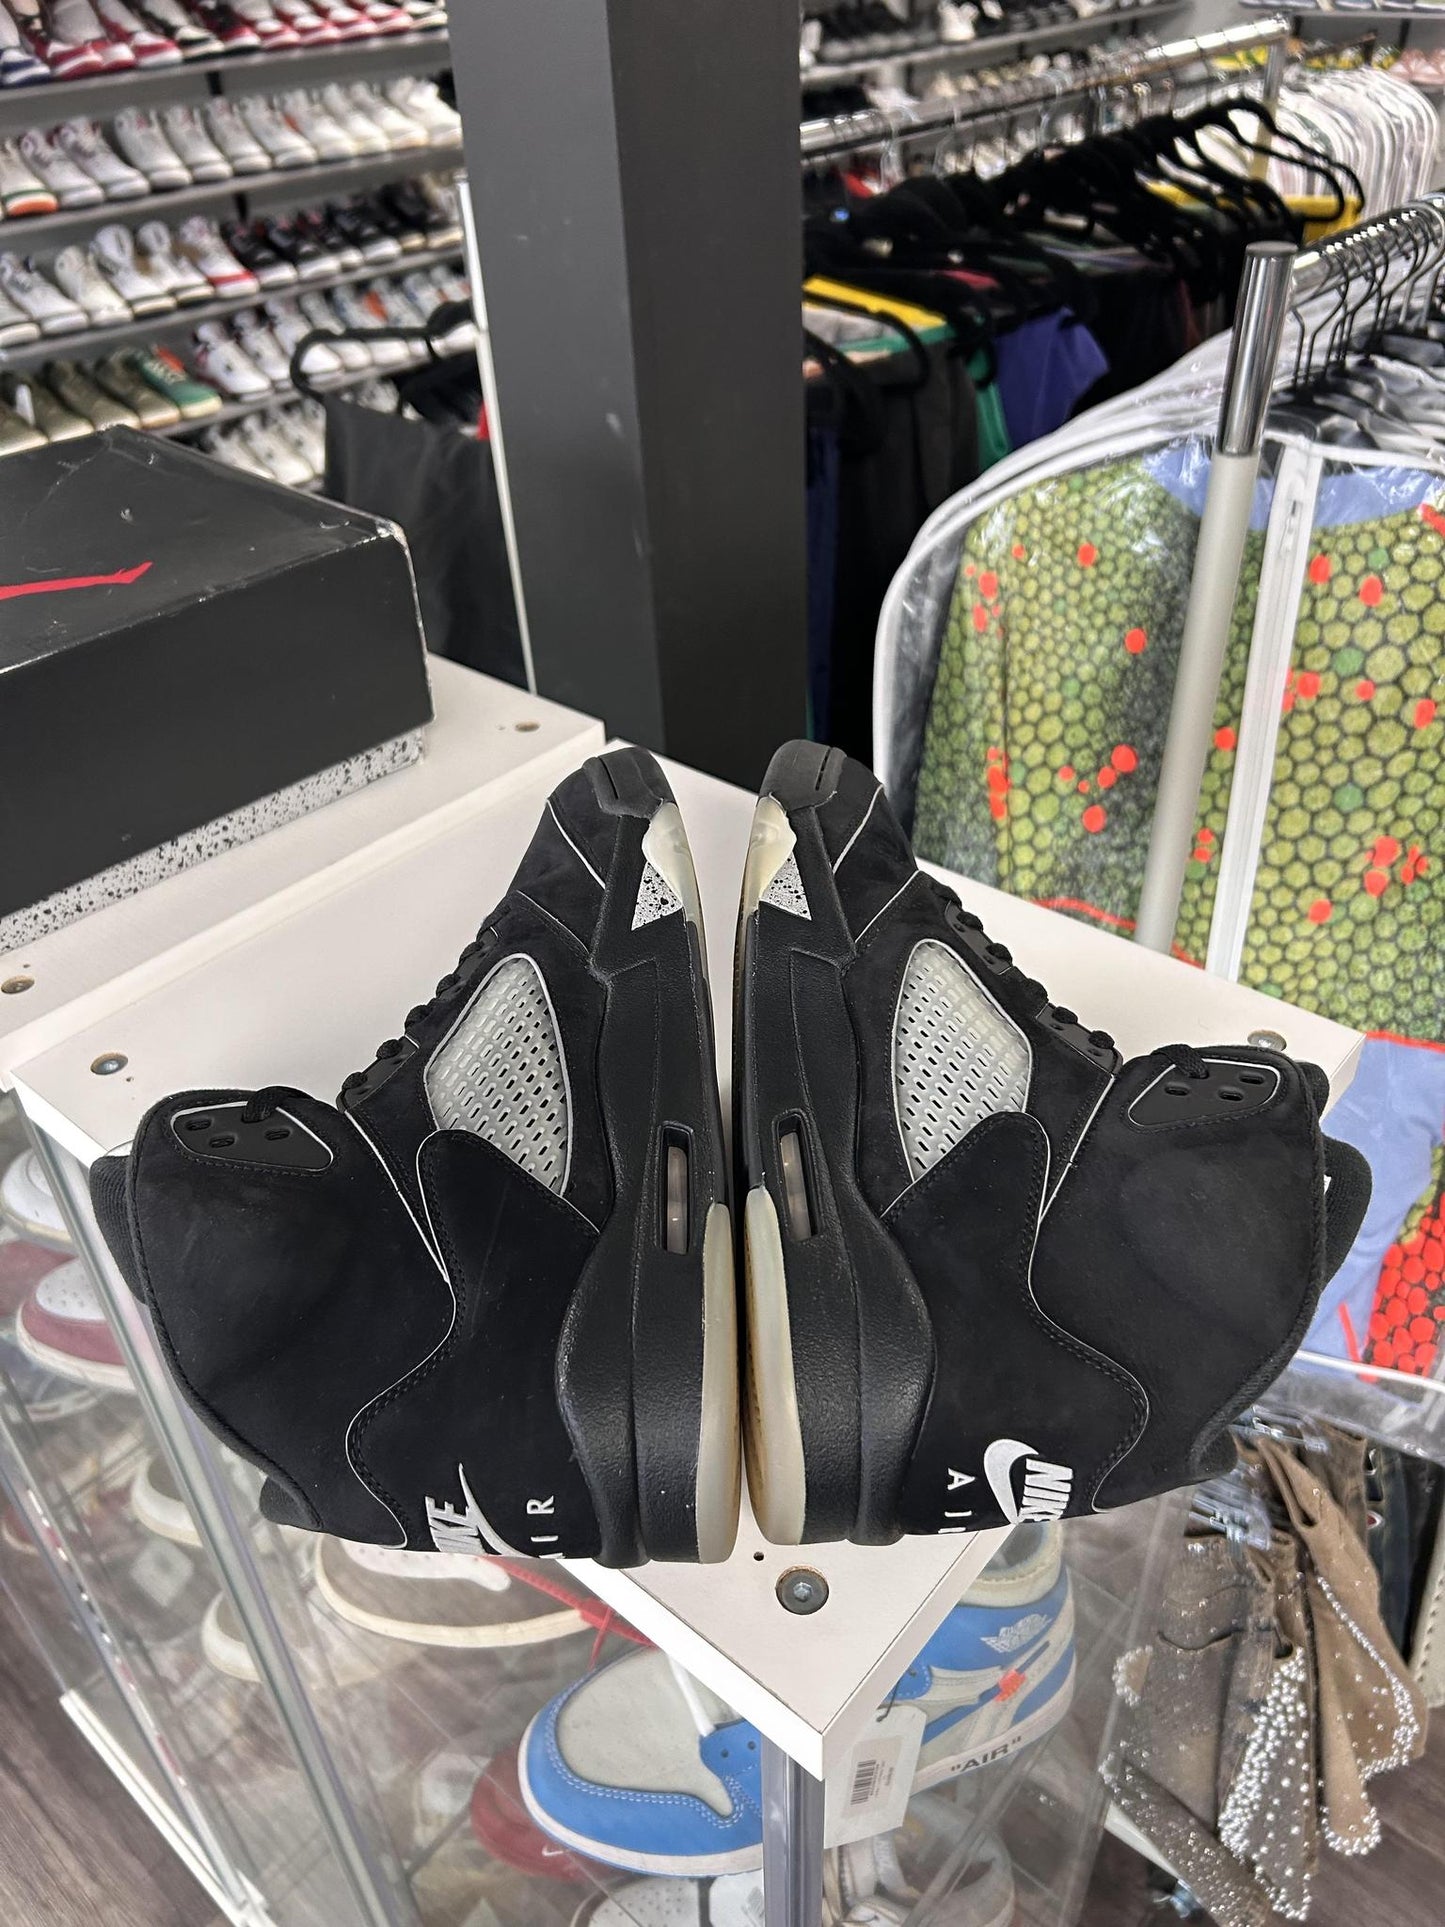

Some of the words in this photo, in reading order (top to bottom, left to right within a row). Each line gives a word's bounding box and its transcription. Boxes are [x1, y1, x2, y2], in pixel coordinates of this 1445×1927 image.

[425, 1495, 486, 1555] IKE
[526, 1494, 566, 1559] IR
[938, 1467, 976, 1534] AI
